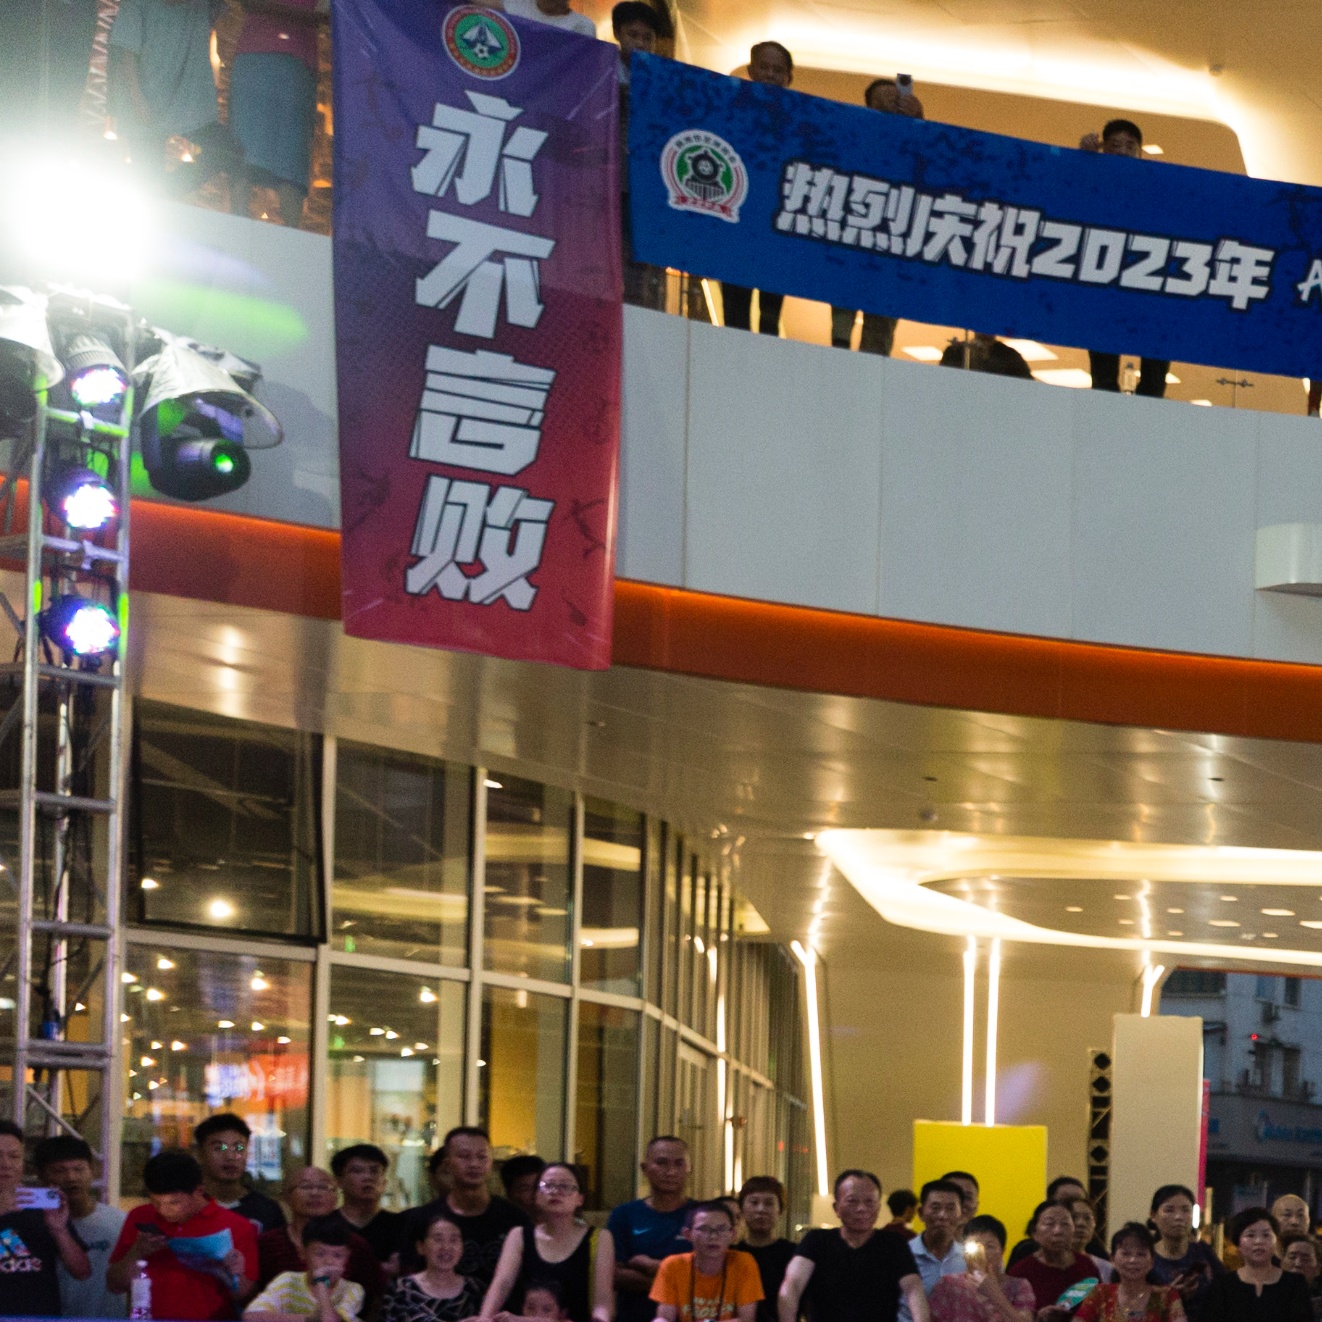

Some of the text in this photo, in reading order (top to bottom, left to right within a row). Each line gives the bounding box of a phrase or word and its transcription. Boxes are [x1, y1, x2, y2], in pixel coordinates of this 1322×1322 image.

[405, 90, 557, 612] 永不言败
[776, 162, 1275, 309] 热烈庆祝2023年
